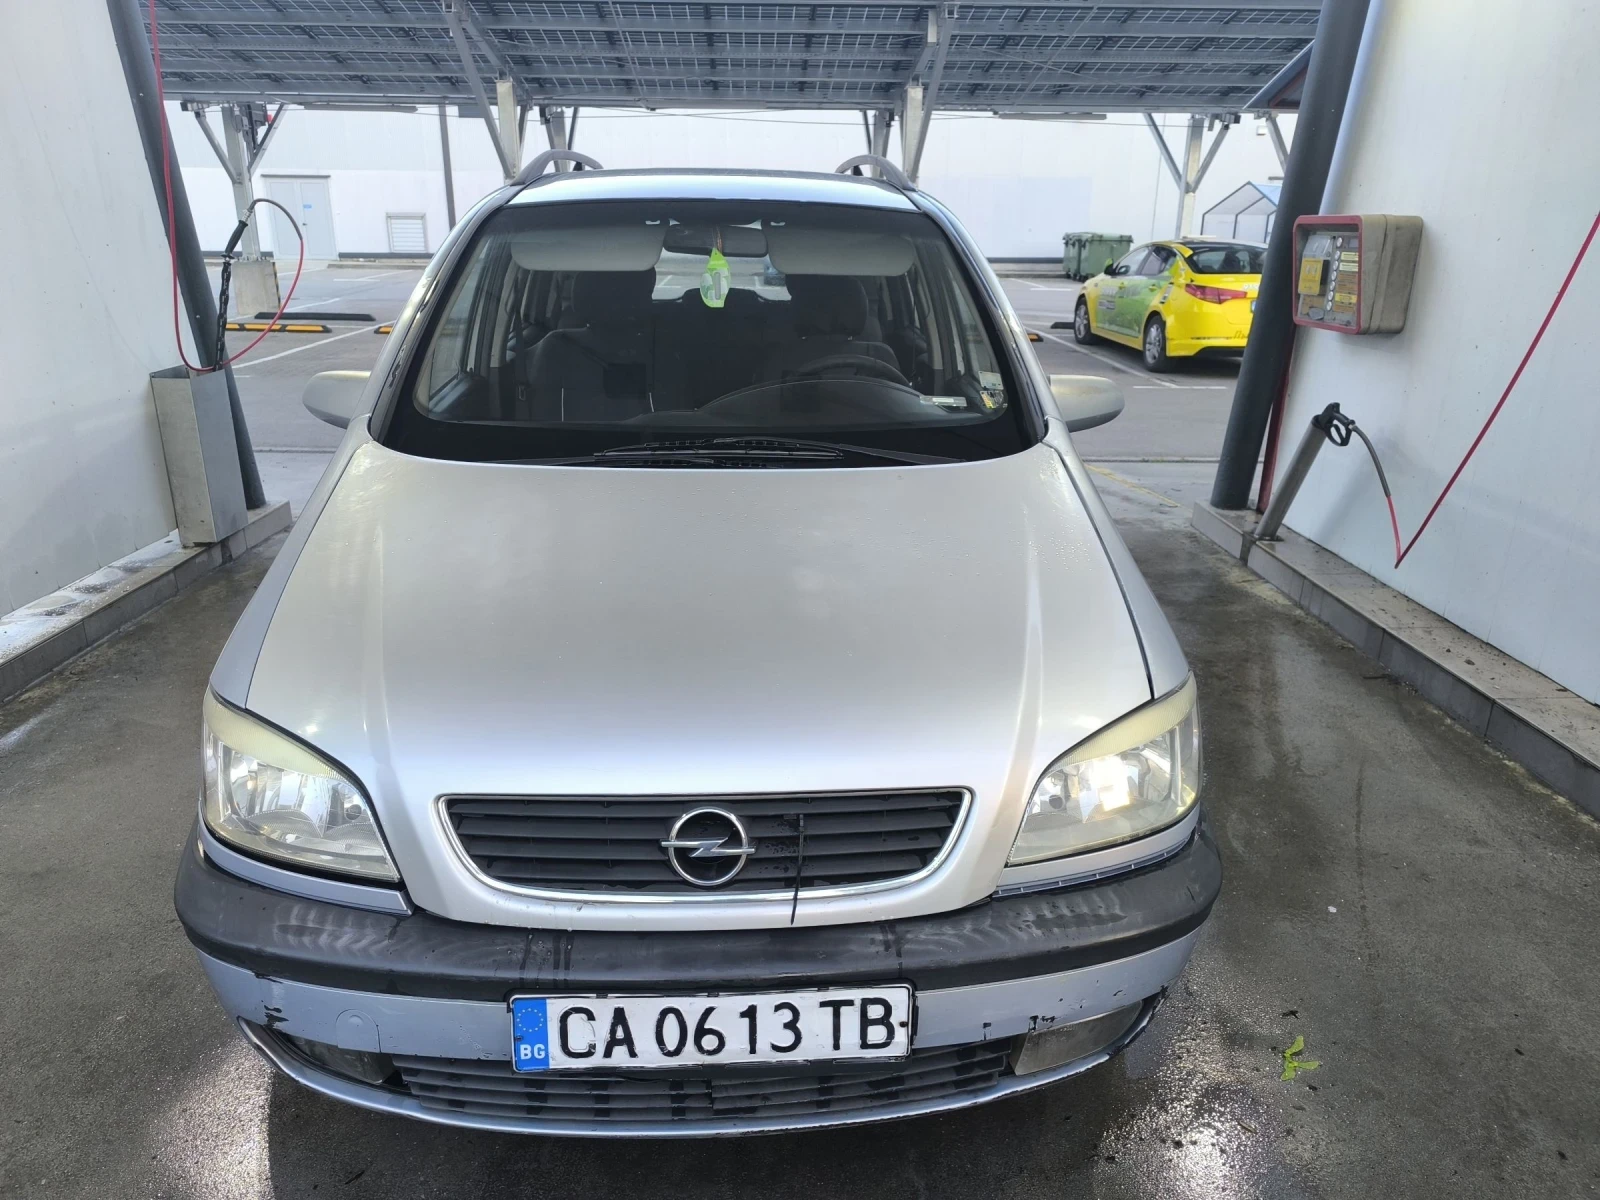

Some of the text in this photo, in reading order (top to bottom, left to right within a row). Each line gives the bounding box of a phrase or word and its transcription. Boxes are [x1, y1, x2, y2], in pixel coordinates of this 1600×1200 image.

[559, 997, 896, 1059] CA 0613 TB
[520, 1044, 546, 1060] BG
